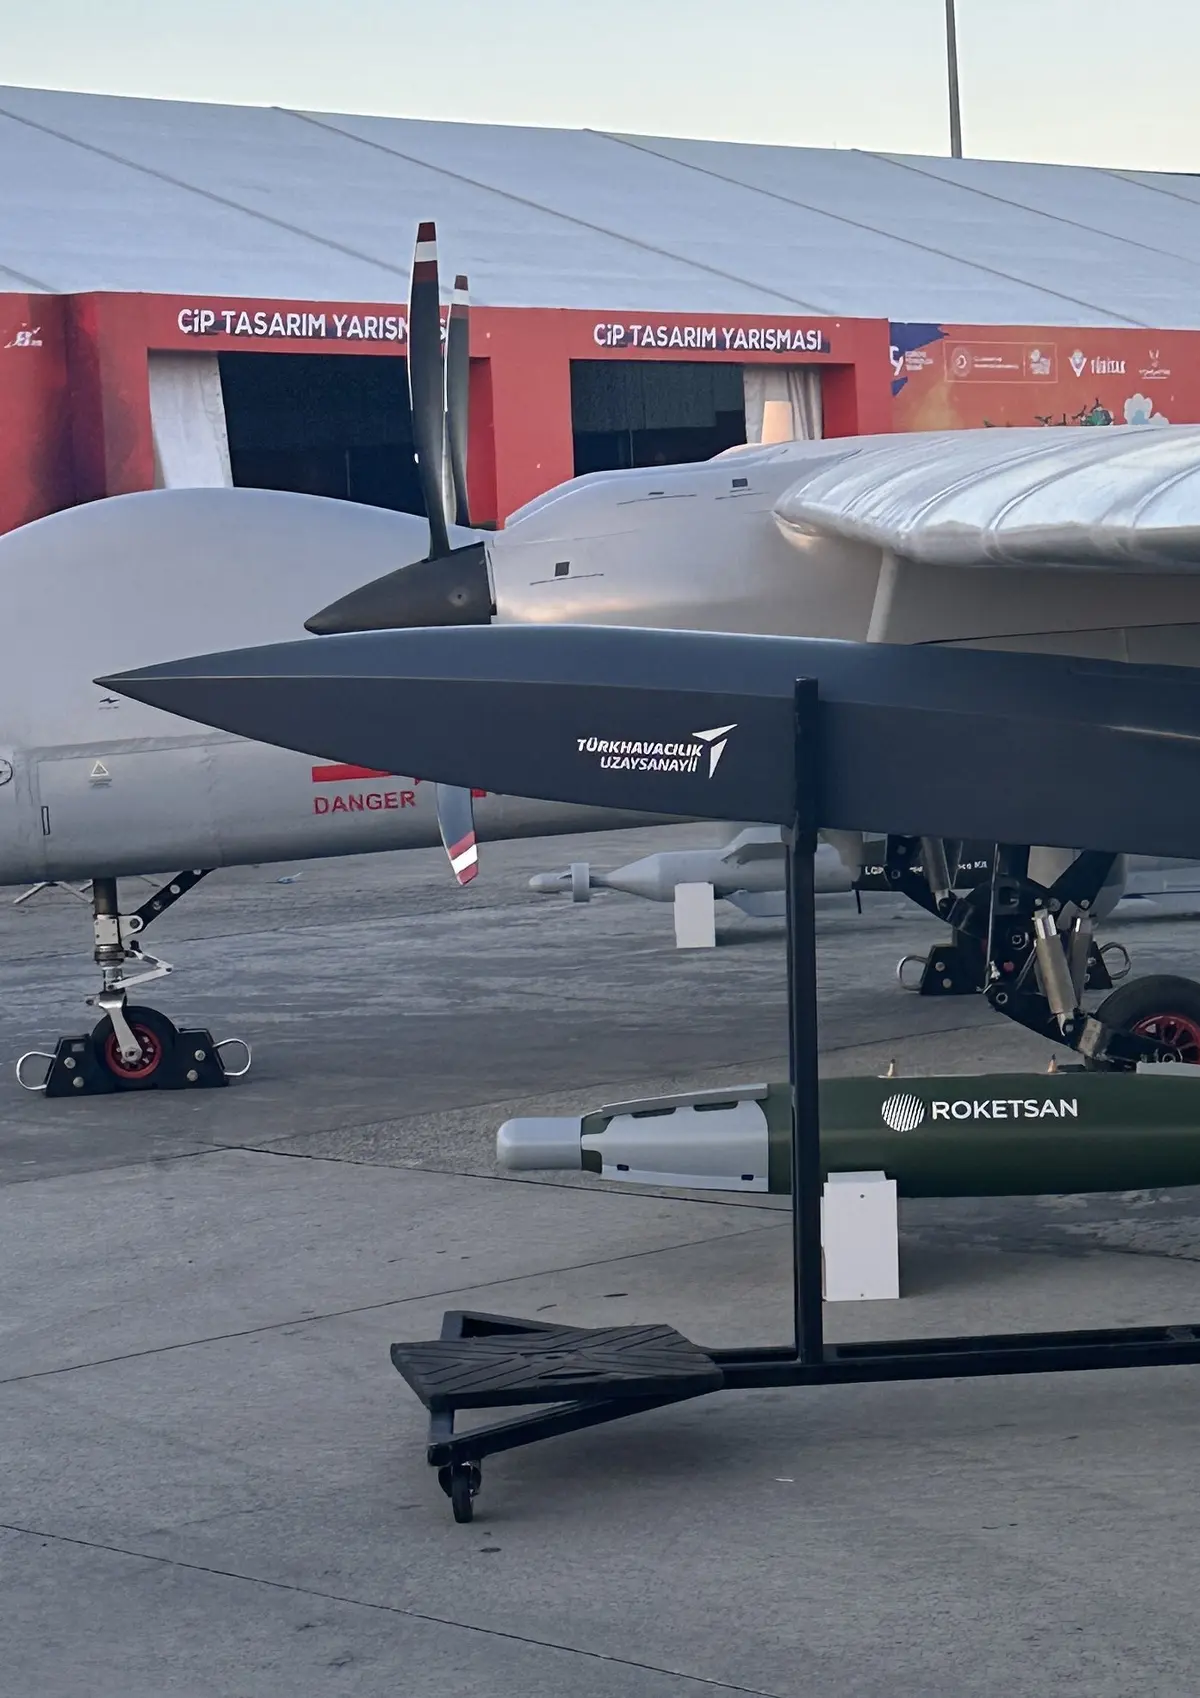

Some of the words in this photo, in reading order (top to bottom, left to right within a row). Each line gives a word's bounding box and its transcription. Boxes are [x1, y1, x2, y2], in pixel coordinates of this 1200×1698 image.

[220, 310, 327, 337] TASARIM
[629, 325, 717, 349] TASARIM
[314, 791, 417, 814] DANGER
[931, 1098, 1079, 1121] ROKETSAN
